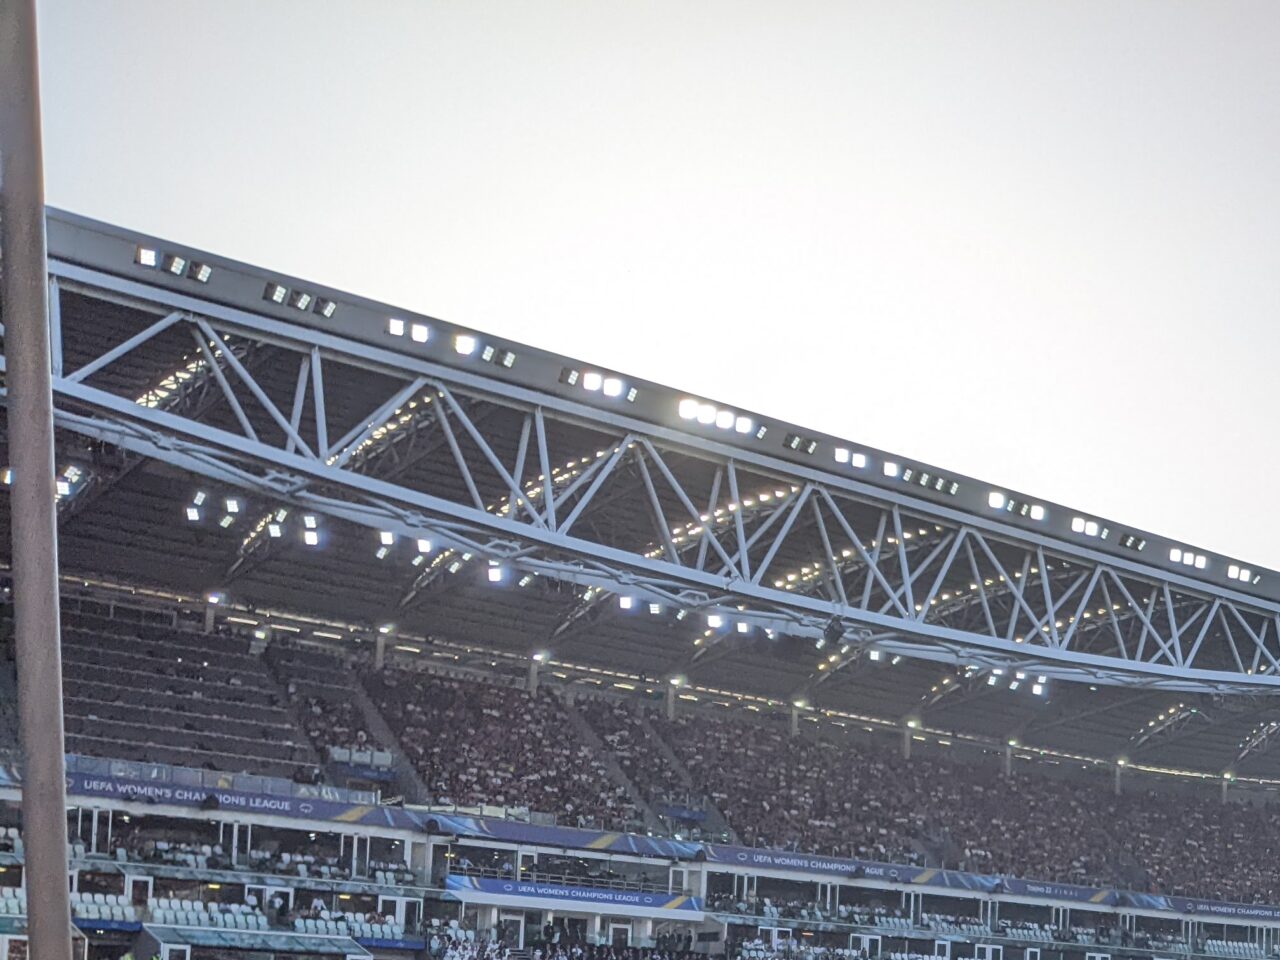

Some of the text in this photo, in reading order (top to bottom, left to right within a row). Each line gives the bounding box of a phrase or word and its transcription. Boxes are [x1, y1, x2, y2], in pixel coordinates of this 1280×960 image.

[84, 780, 291, 811] UEFA WOMEN'S CHAIONS LEAGUE
[753, 855, 772, 864] UEFA
[774, 857, 809, 868] WOMEN'S
[810, 860, 856, 873] CHAMPIONS
[518, 885, 640, 903] UEFA WOMEN'S CHAMPIONS LEAGUE
[1236, 908, 1273, 917] CHAMPIONS
